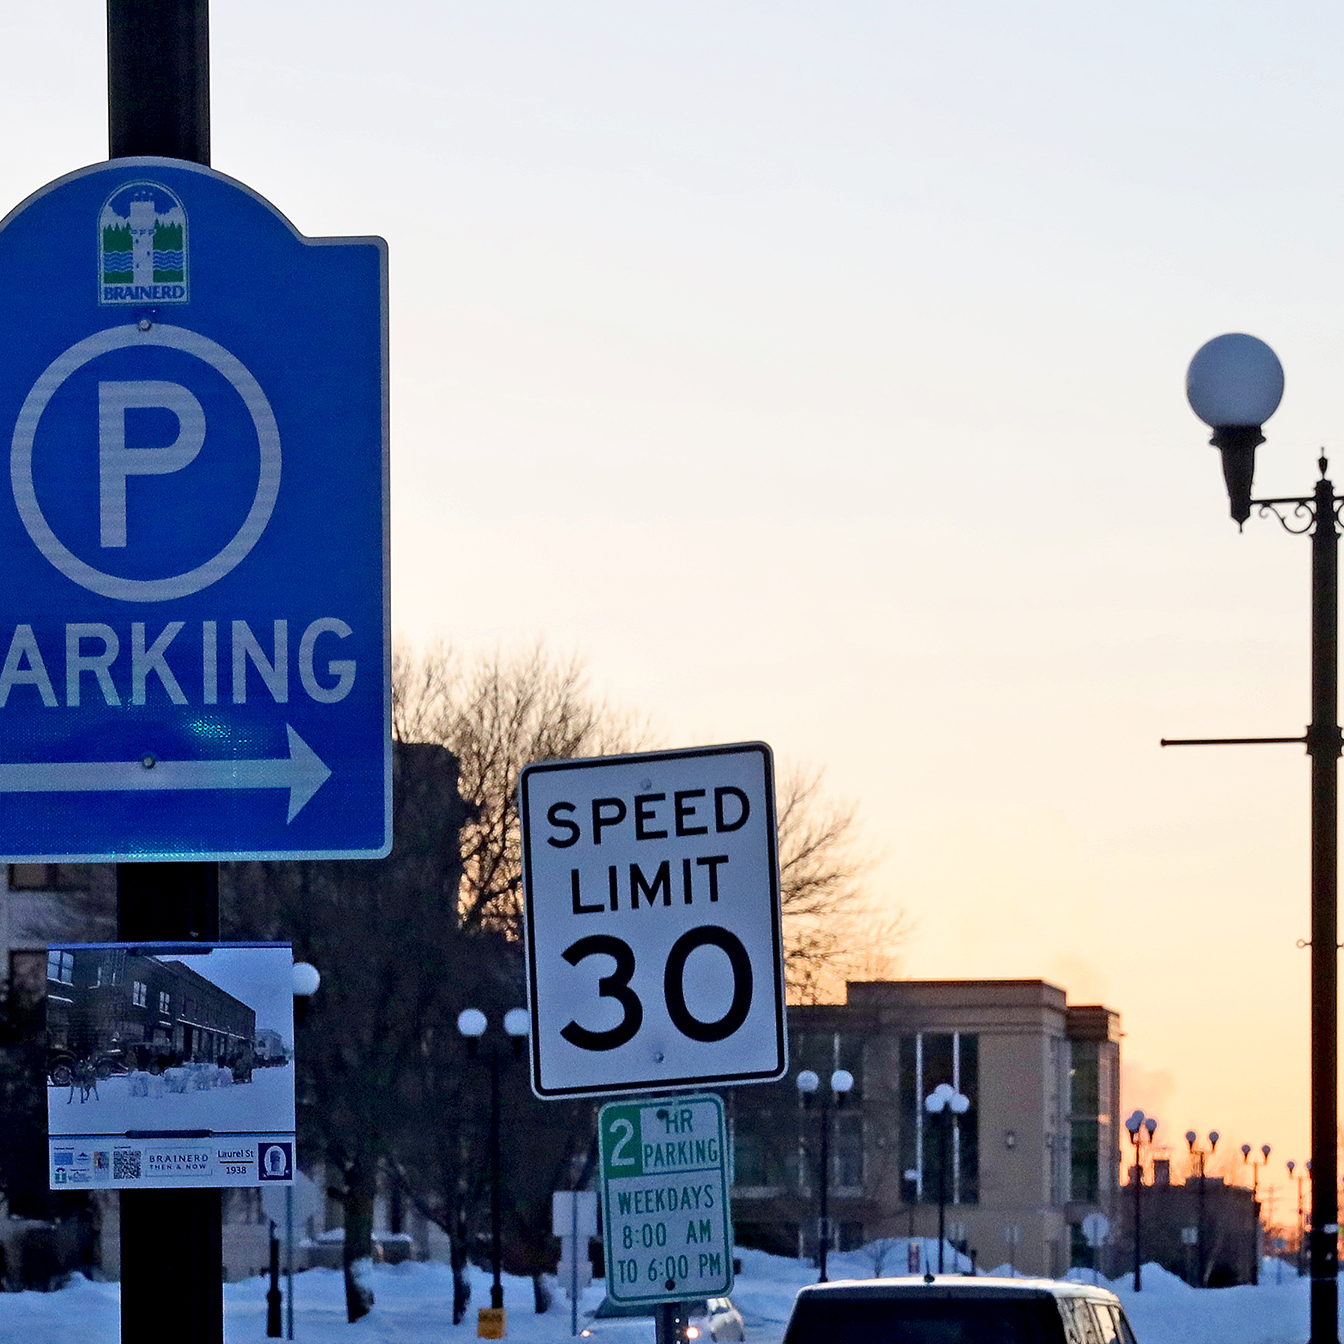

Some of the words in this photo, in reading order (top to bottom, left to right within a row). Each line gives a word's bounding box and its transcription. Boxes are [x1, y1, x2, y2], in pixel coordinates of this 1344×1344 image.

[104, 285, 185, 300] BRAINERD
[98, 380, 206, 547] P
[547, 786, 750, 848] SPEED
[570, 855, 729, 914] LIMIT
[559, 925, 753, 1051] 30
[609, 1118, 636, 1166] 2
[665, 1109, 693, 1134] HR
[149, 1154, 209, 1163] BRAINERD
[217, 1149, 244, 1158] Laurel
[246, 1149, 254, 1158] St
[644, 1139, 717, 1167] PARKING
[226, 1166, 247, 1175] 1938
[618, 1184, 715, 1215] WEEKDAYS
[623, 1222, 667, 1249] 8:00
[686, 1219, 711, 1244] AM
[618, 1259, 638, 1283] TO
[648, 1254, 688, 1281] 6:00
[698, 1253, 721, 1277] PM
